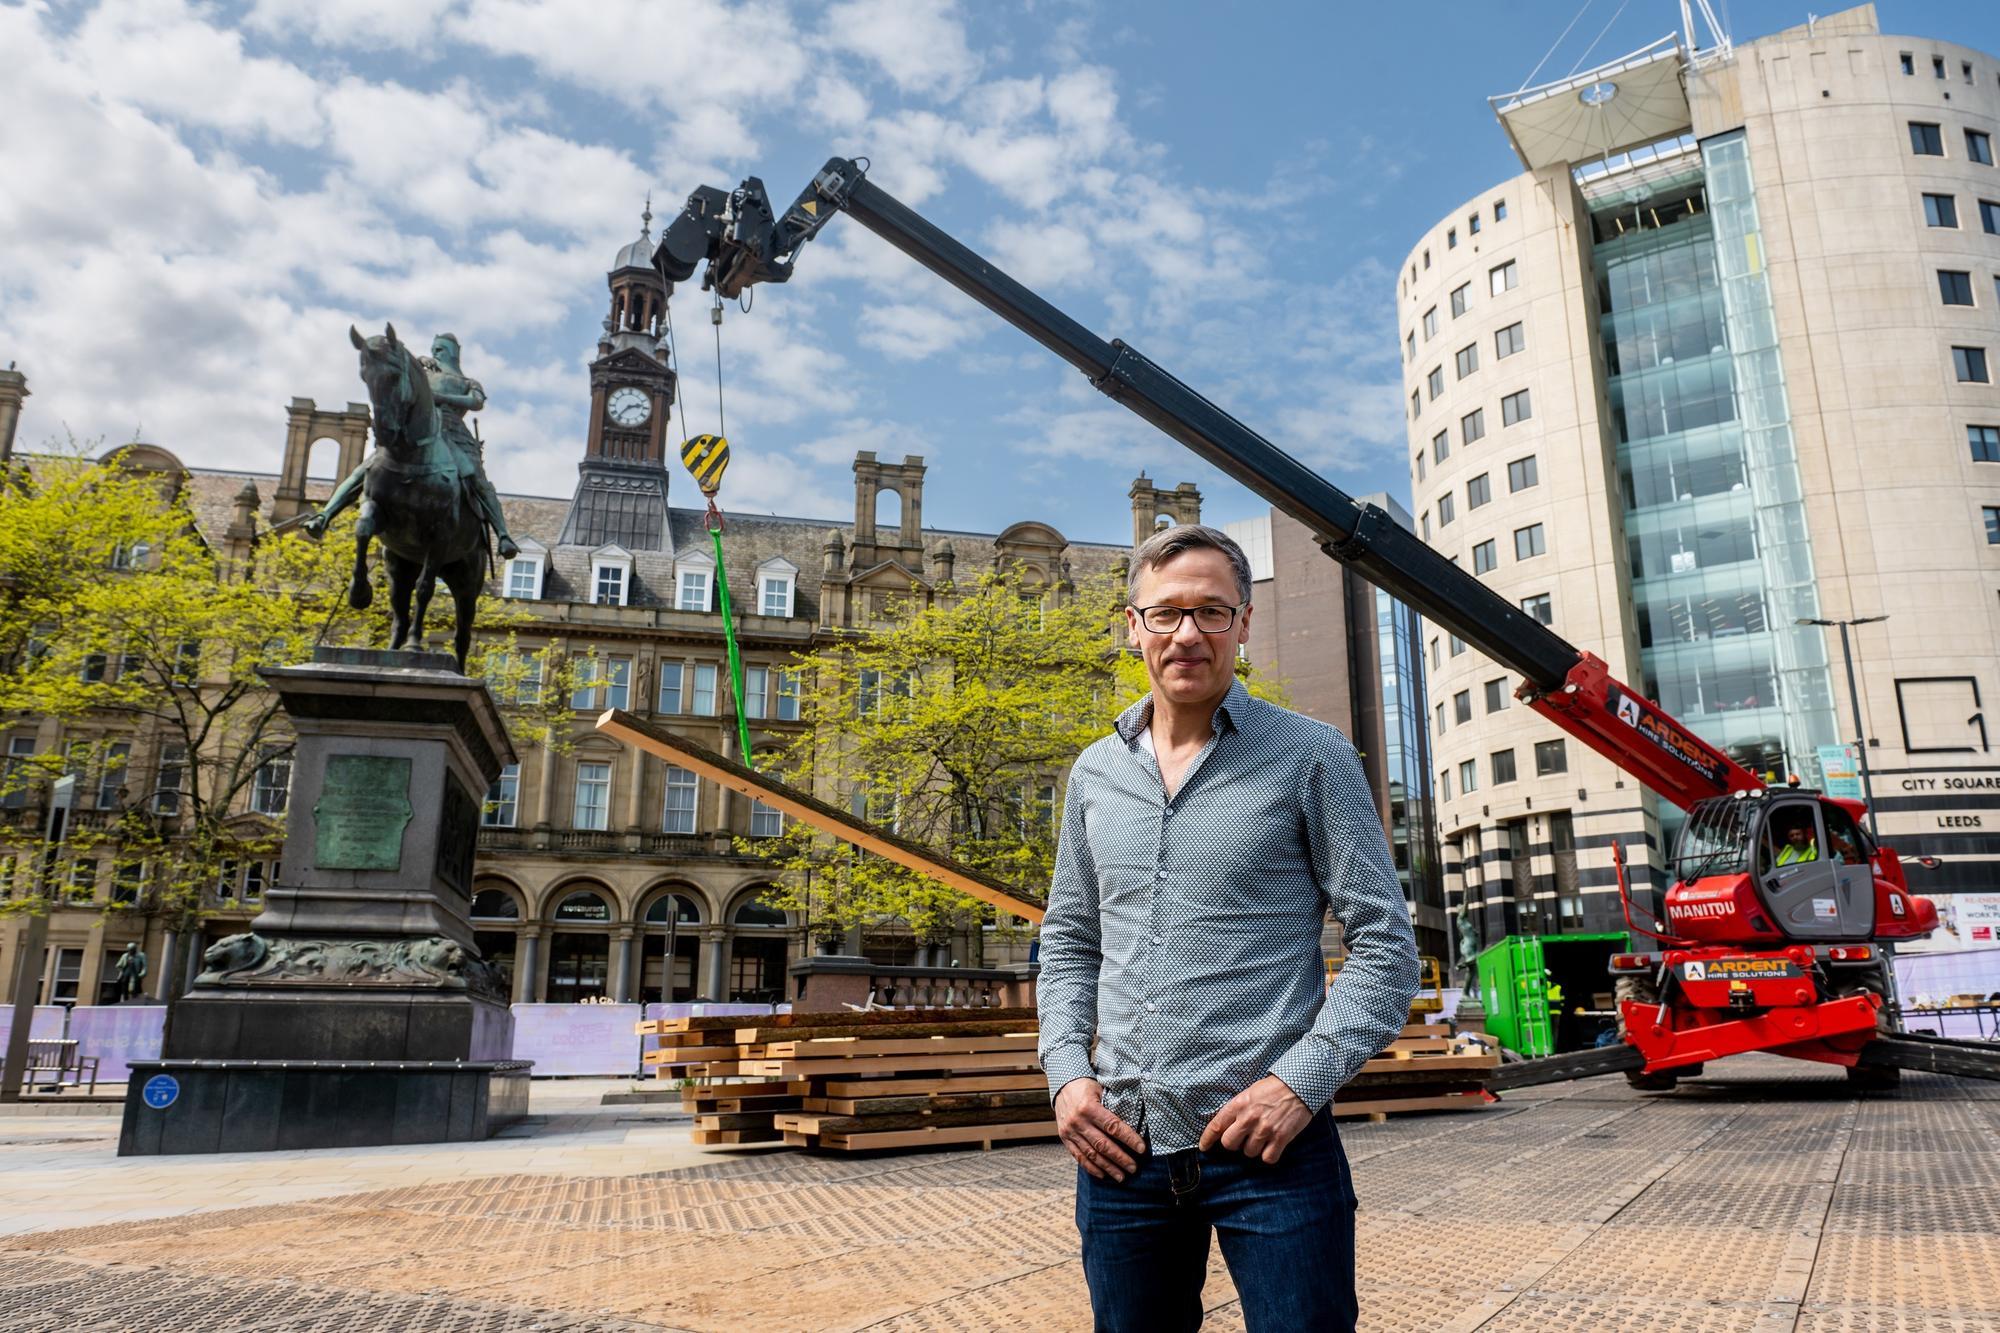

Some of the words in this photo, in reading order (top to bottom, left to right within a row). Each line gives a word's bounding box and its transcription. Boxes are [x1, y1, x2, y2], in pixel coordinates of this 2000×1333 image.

[1640, 714, 1719, 769] ARDENT
[1638, 724, 1660, 743] HIRE
[1661, 741, 1714, 780] SOLUTIONS
[1902, 779, 1936, 790] CITY
[1937, 816, 1982, 827] LEEDS
[1669, 901, 1736, 919] MANITOU
[1708, 960, 1789, 972] ARDENT
